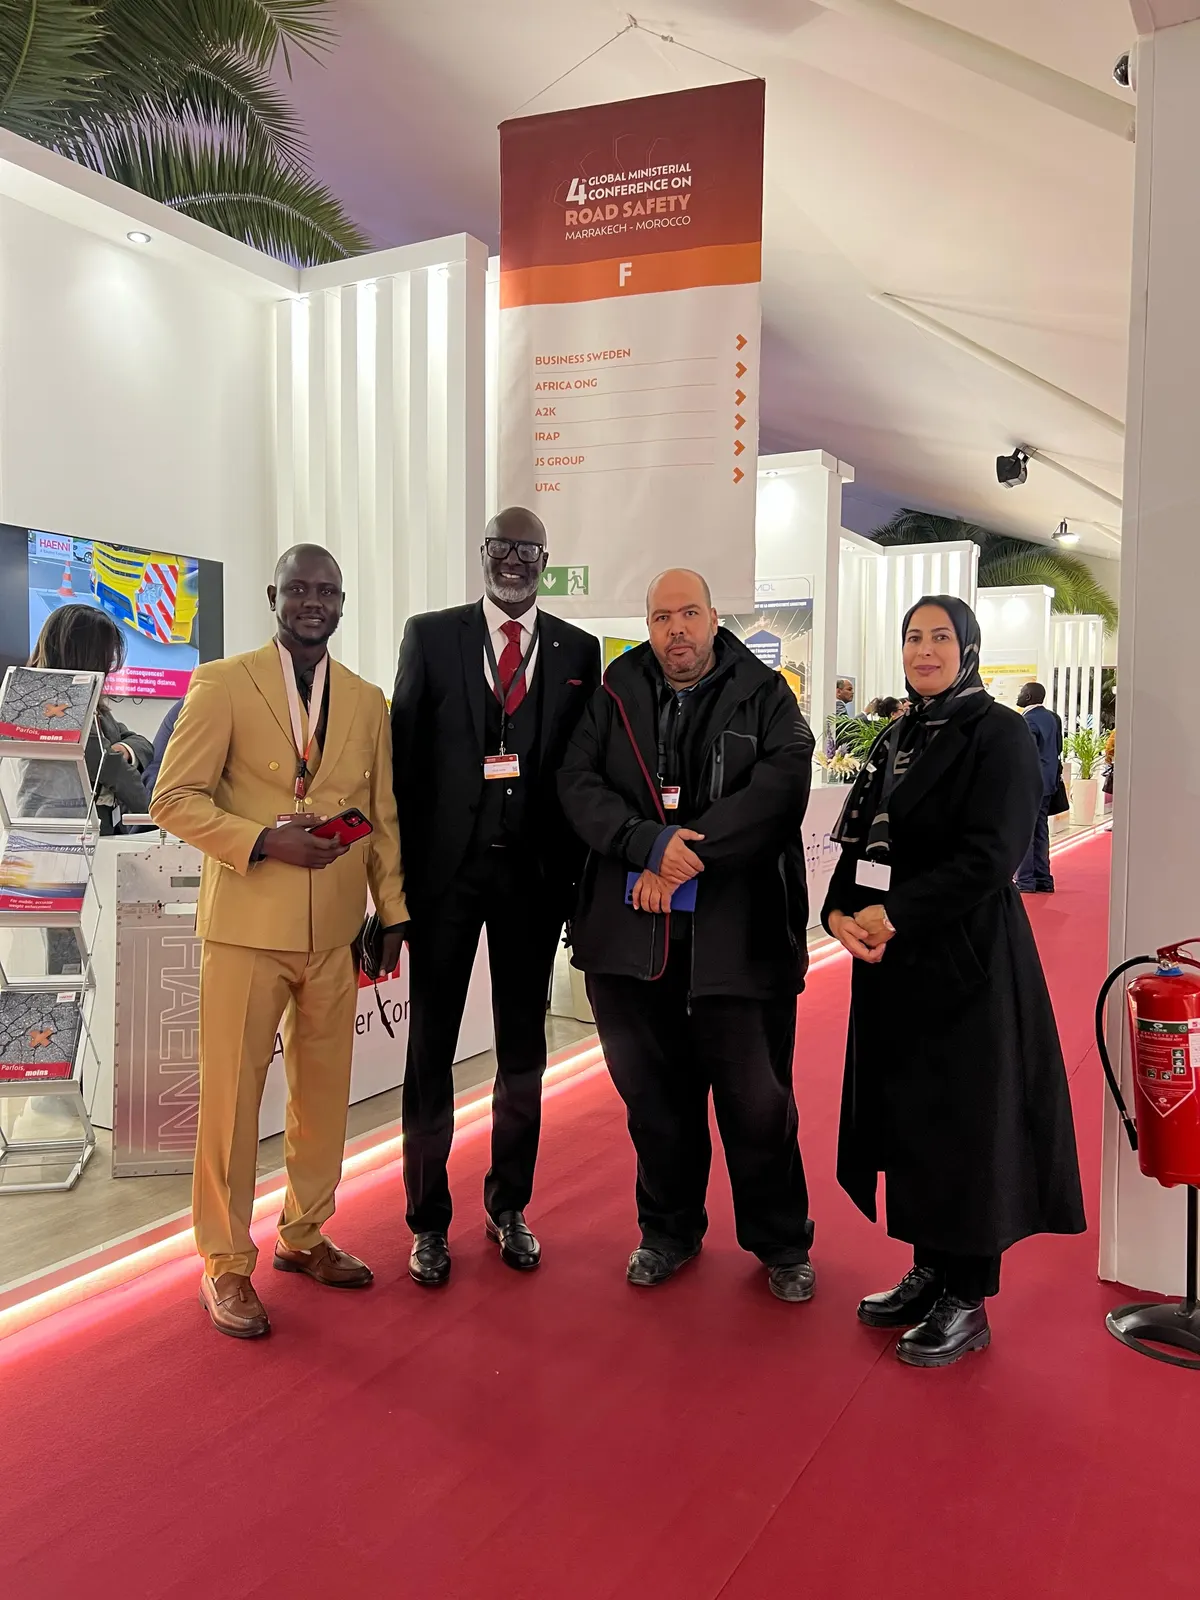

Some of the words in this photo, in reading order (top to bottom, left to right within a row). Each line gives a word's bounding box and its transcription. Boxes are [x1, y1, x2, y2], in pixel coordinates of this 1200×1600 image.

[588, 172, 626, 186] GLOBAL
[628, 162, 691, 180] MINISTERIAL
[588, 178, 669, 200] CONFERENCE
[671, 175, 691, 189] ON
[565, 203, 619, 226] ROAD
[622, 194, 691, 218] SAFETY
[565, 223, 627, 240] MARRAKECH
[636, 215, 691, 230] MOROCCO
[619, 262, 633, 287] F
[535, 353, 585, 366] BUSINESS
[586, 348, 631, 362] SWEDEN
[534, 381, 572, 391] AFRICA
[574, 378, 598, 390] ONG
[534, 407, 557, 417] A2K
[534, 431, 560, 441] IRAP
[534, 457, 545, 467] JS
[547, 455, 585, 467] GROUP
[535, 482, 561, 492] UTAC
[139, 677, 157, 686] braking
[15, 726, 40, 736] Parfois,
[1, 1064, 26, 1072] Parfois,
[24, 1069, 49, 1077] moins
